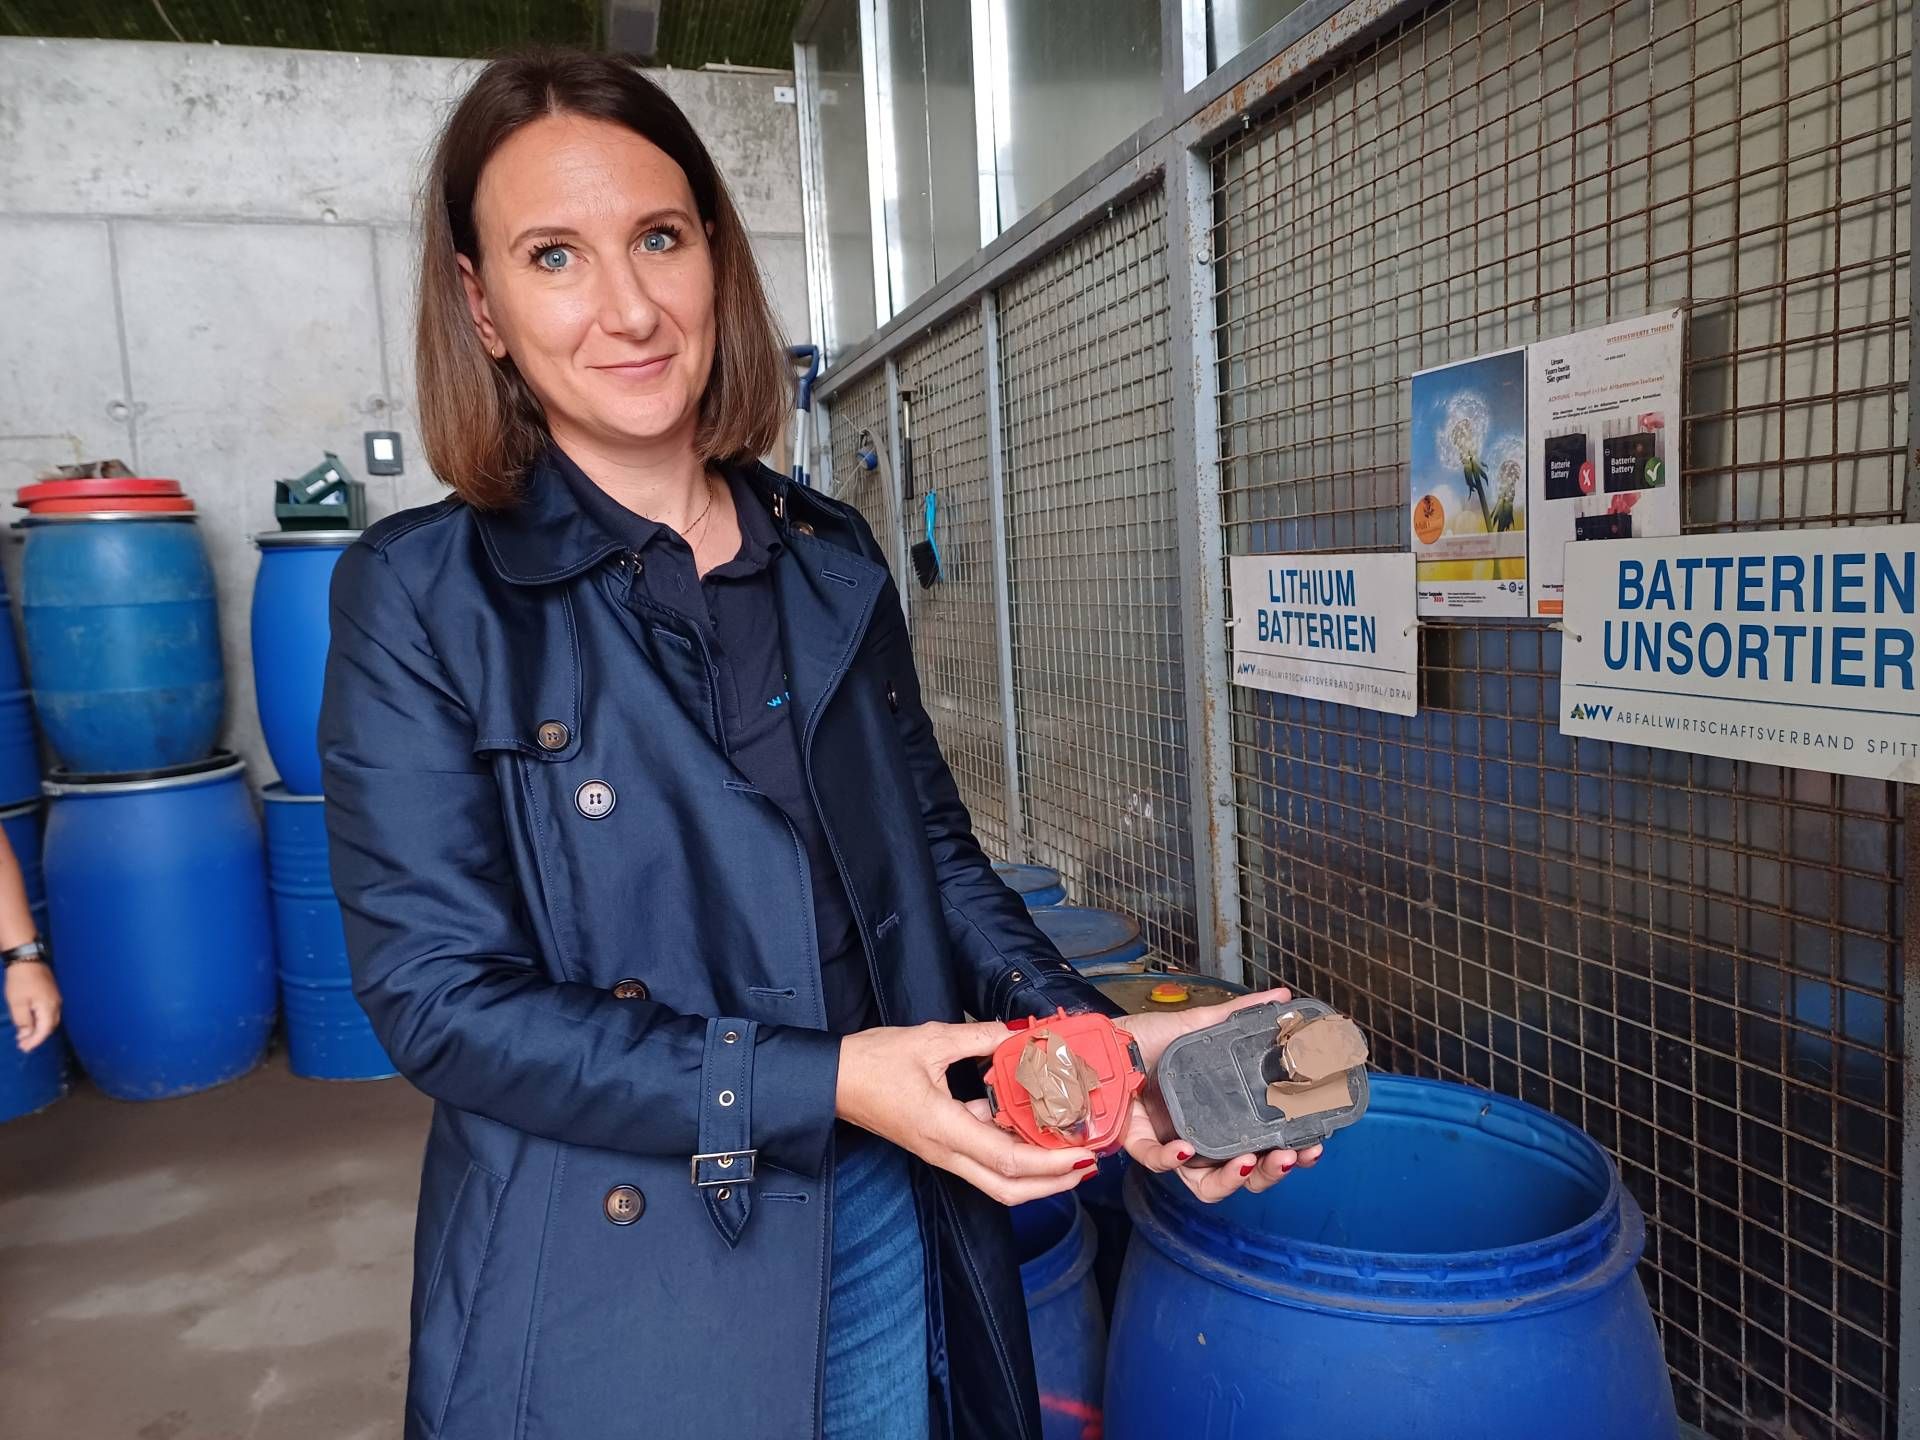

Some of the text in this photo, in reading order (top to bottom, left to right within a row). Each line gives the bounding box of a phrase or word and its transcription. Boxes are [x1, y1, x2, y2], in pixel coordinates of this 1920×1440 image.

[1545, 368, 1558, 376] Team
[1550, 460, 1571, 470] Batterie
[1550, 470, 1569, 480] Battery
[1611, 456, 1636, 466] Batterie
[1611, 465, 1634, 475] Battery
[1269, 569, 1356, 607] LITHIUM
[1618, 551, 1916, 614] BATTERIEN
[1257, 608, 1376, 654] BATTERIEN
[1604, 620, 1915, 690] UNSORTIER
[1237, 662, 1413, 701] AWV ABFALLWIRTSCHAFTSVERBAND SPITTAL/DRAU
[1570, 702, 1614, 722] AWV
[1616, 711, 1855, 751] ABFALLWIRTSCHAFTSVERBAND
